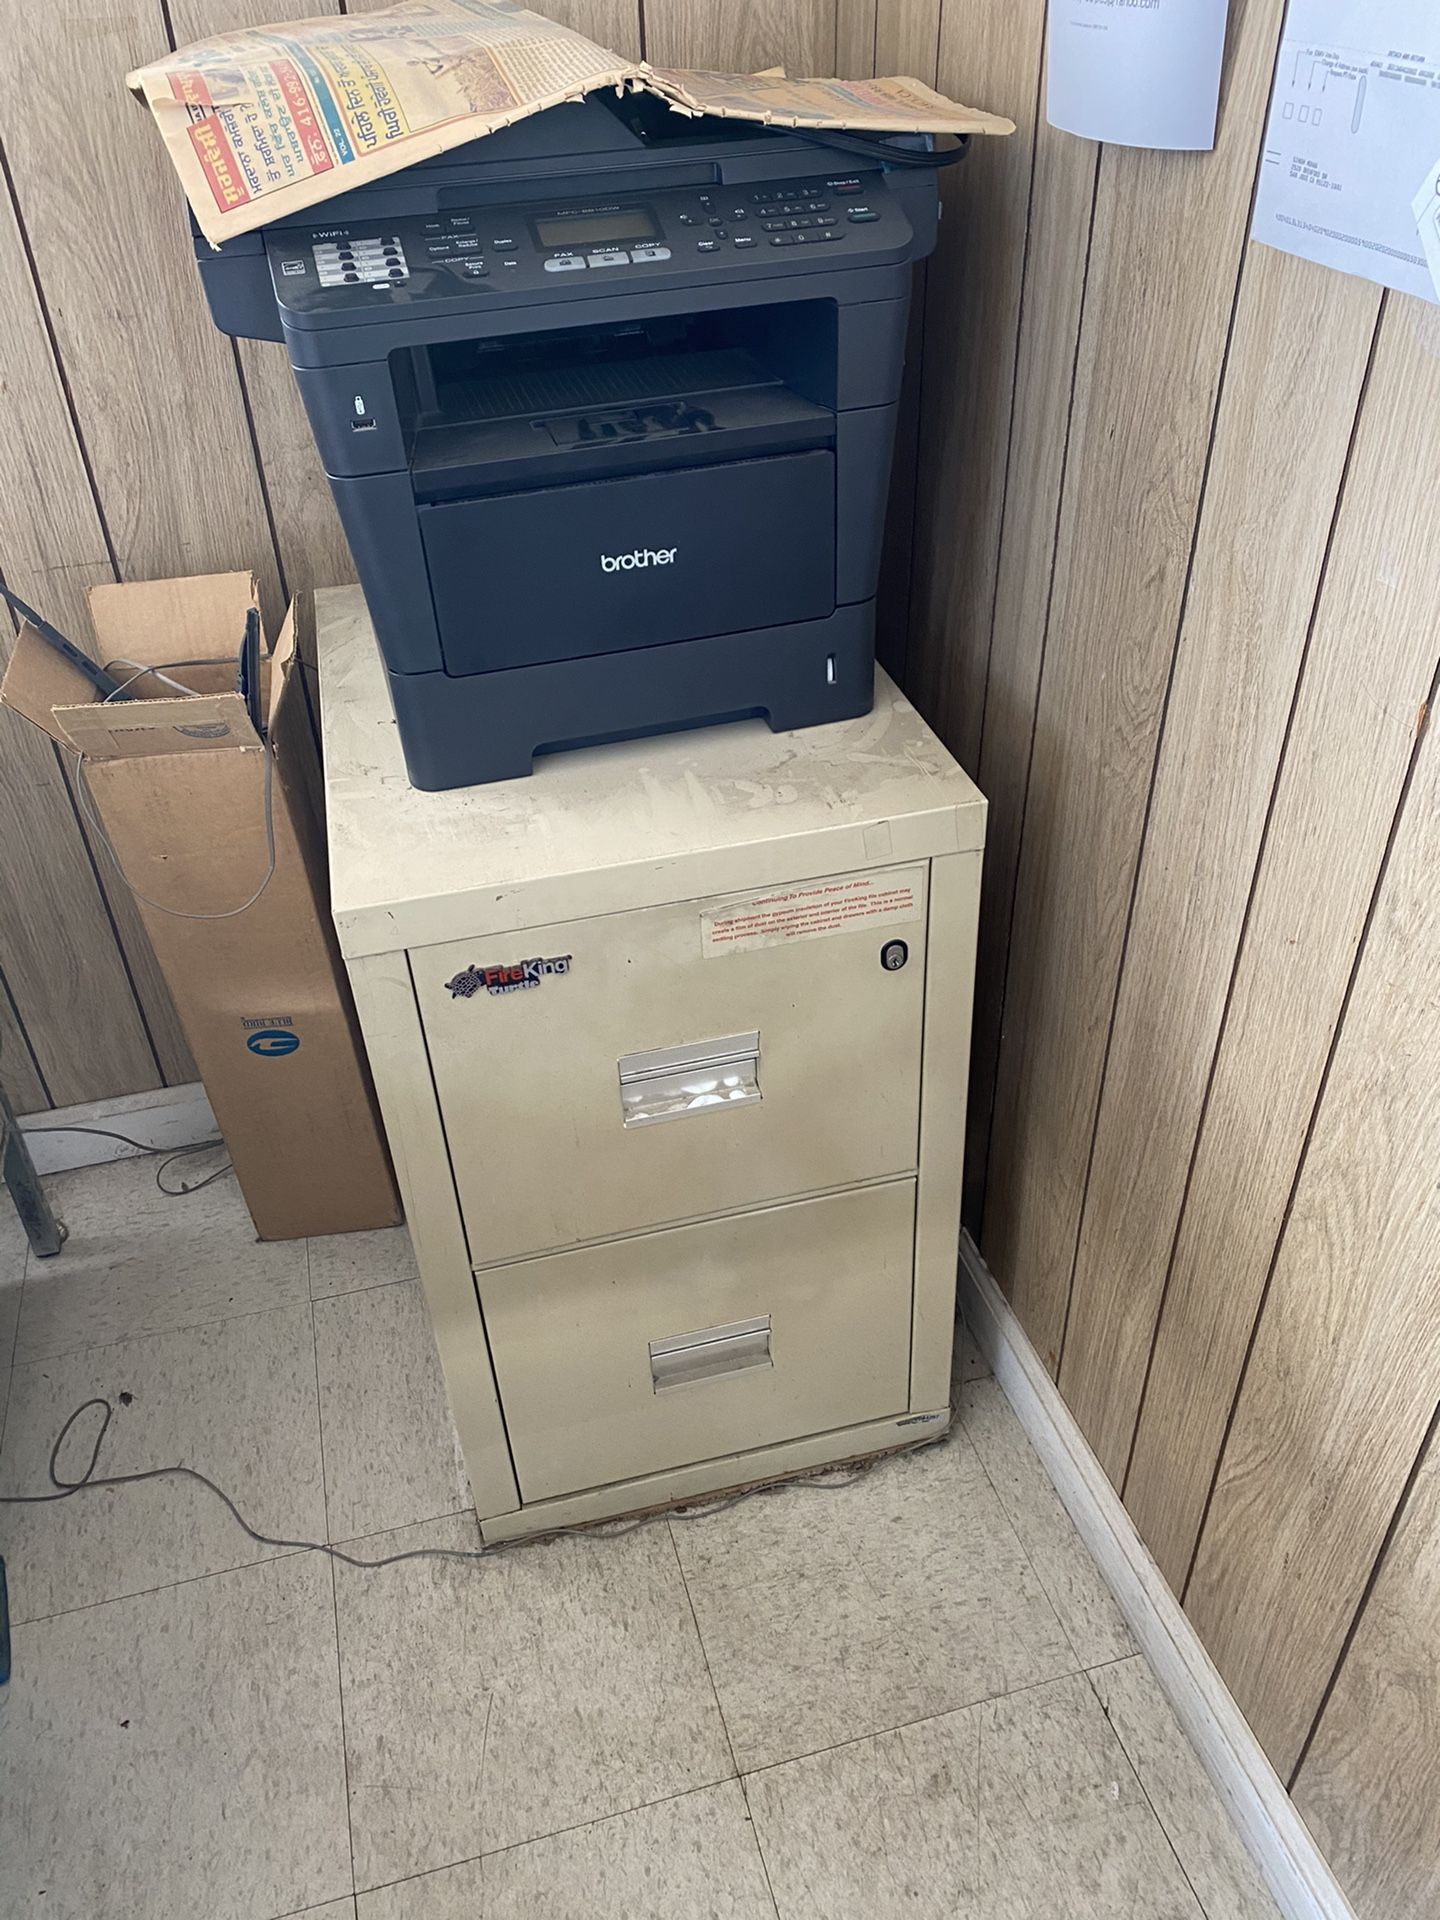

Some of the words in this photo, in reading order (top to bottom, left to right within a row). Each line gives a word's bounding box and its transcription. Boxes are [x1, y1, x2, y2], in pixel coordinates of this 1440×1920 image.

[342, 88, 366, 111] ਦਿਨ
[333, 127, 342, 138] 22
[349, 109, 380, 149] ਪਹਿਲੇ
[376, 105, 405, 140] ਘਿਰੀ
[337, 137, 349, 157] VOL.
[237, 149, 263, 194] ਮਰਦਾਨਾ
[600, 547, 678, 573] brother
[797, 888, 822, 898] Provide
[823, 884, 844, 893] Peace
[711, 927, 729, 935] create
[786, 913, 807, 921] exterior
[819, 907, 840, 915] interior
[893, 894, 913, 902] normal
[713, 918, 733, 927] During
[771, 908, 794, 917] gypsum
[794, 903, 822, 912] insulation
[877, 889, 898, 897] cabinet
[760, 926, 779, 934] Simply
[484, 958, 569, 985] FireKing
